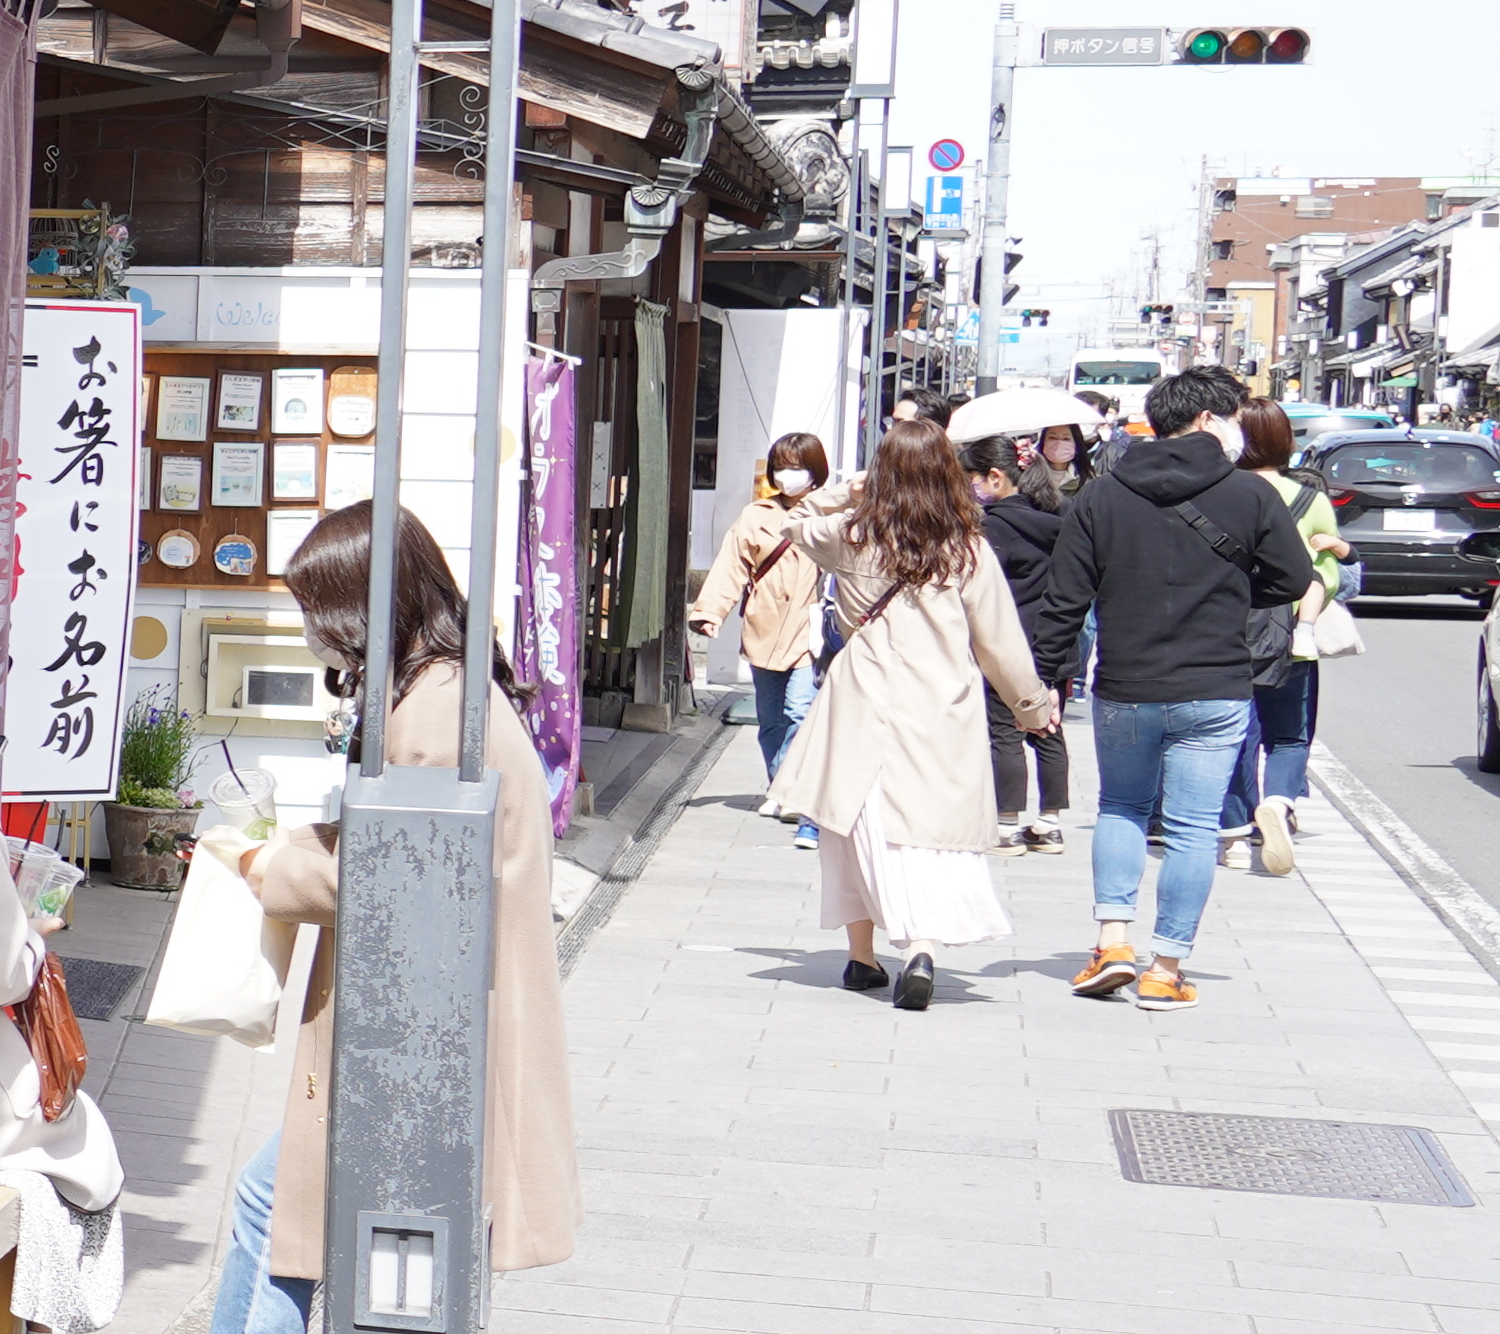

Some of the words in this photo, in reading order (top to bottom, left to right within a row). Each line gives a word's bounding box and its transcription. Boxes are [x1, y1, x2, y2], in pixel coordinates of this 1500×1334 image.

[1052, 35, 1156, 56] 押ボタン信号
[39, 334, 120, 766] お箸にお名前
